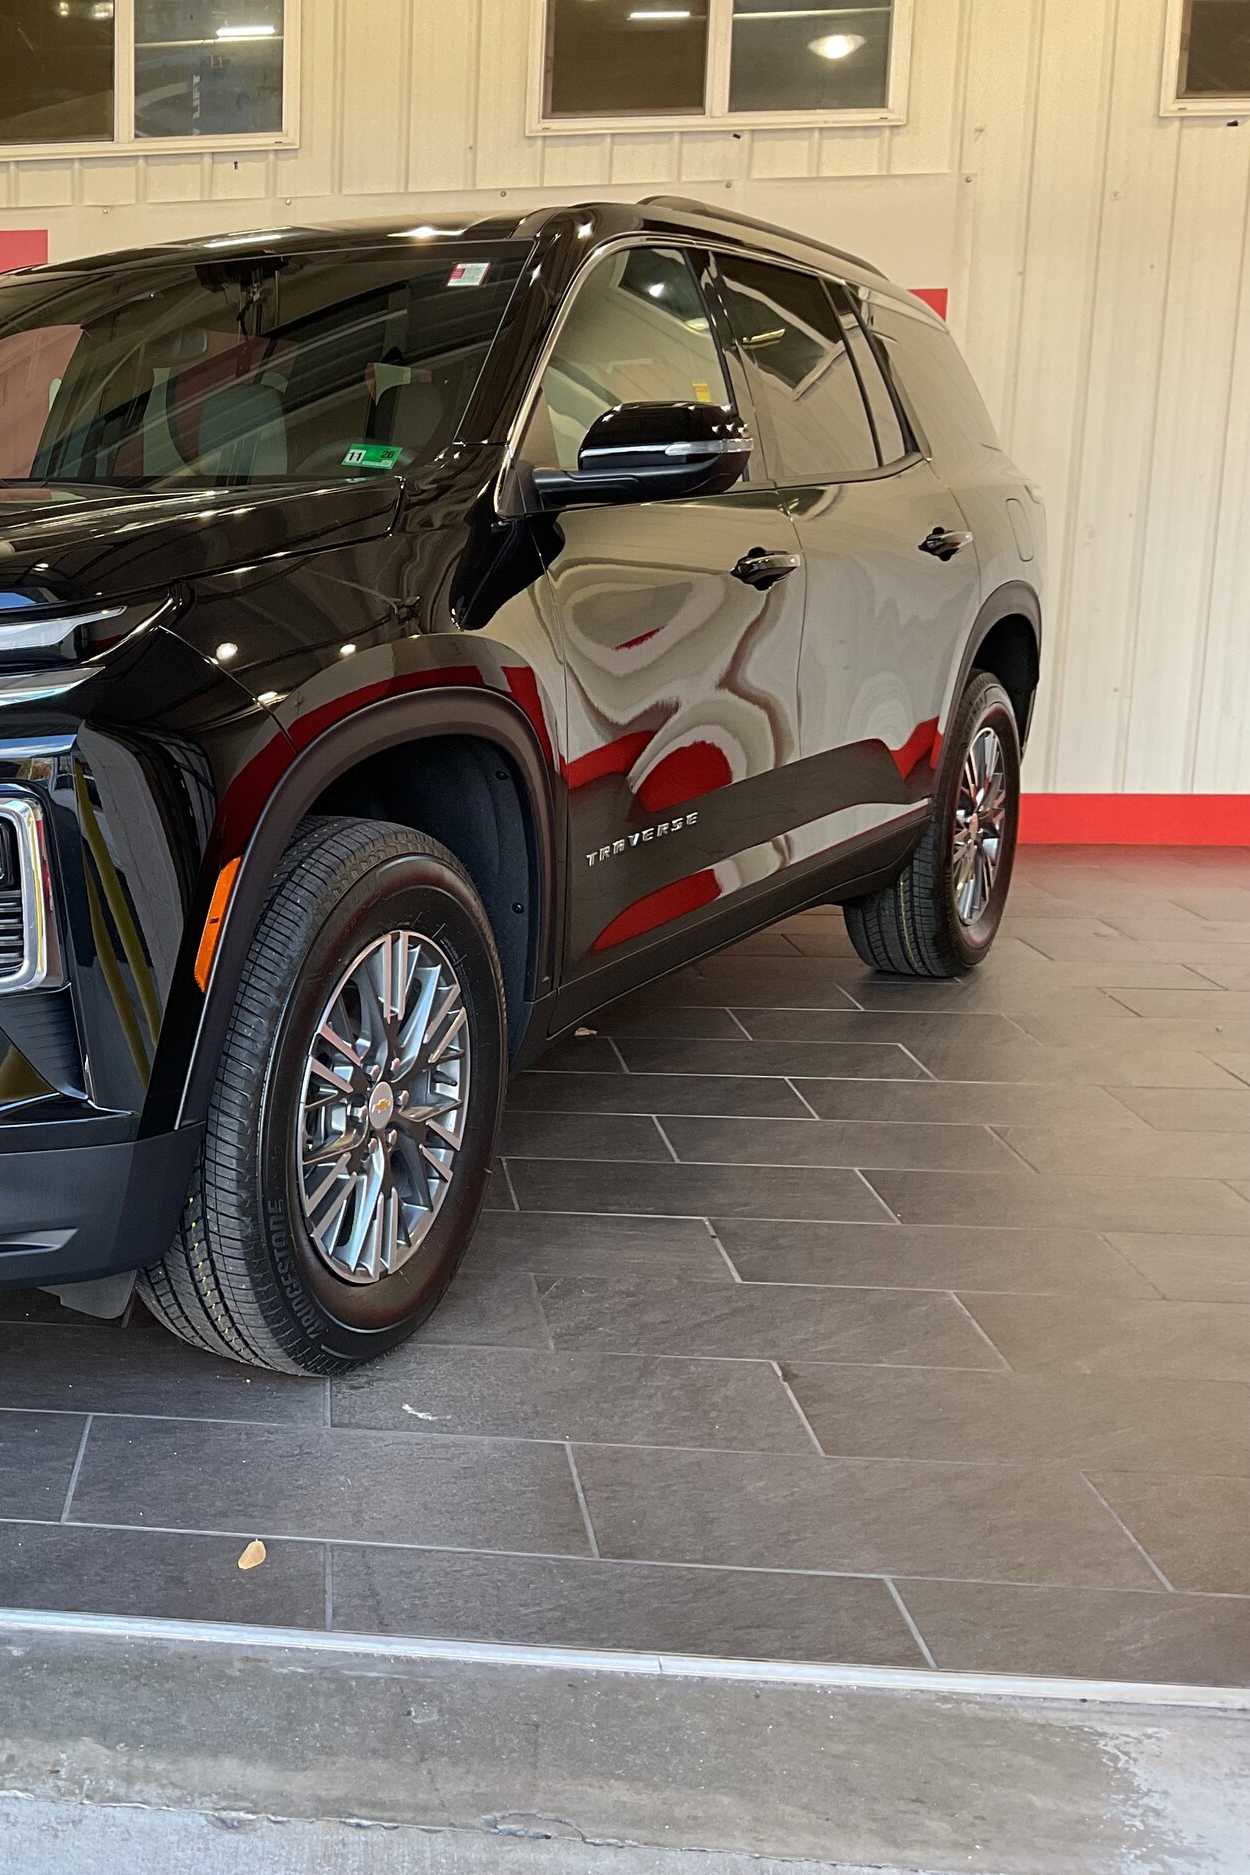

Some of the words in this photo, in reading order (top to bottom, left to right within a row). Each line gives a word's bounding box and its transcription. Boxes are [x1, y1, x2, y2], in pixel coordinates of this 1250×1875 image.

[192, 74, 200, 119] LIFT
[348, 452, 363, 461] 11
[586, 811, 698, 867] TRAVERSE
[267, 1198, 324, 1340] BRIDGESTONE
